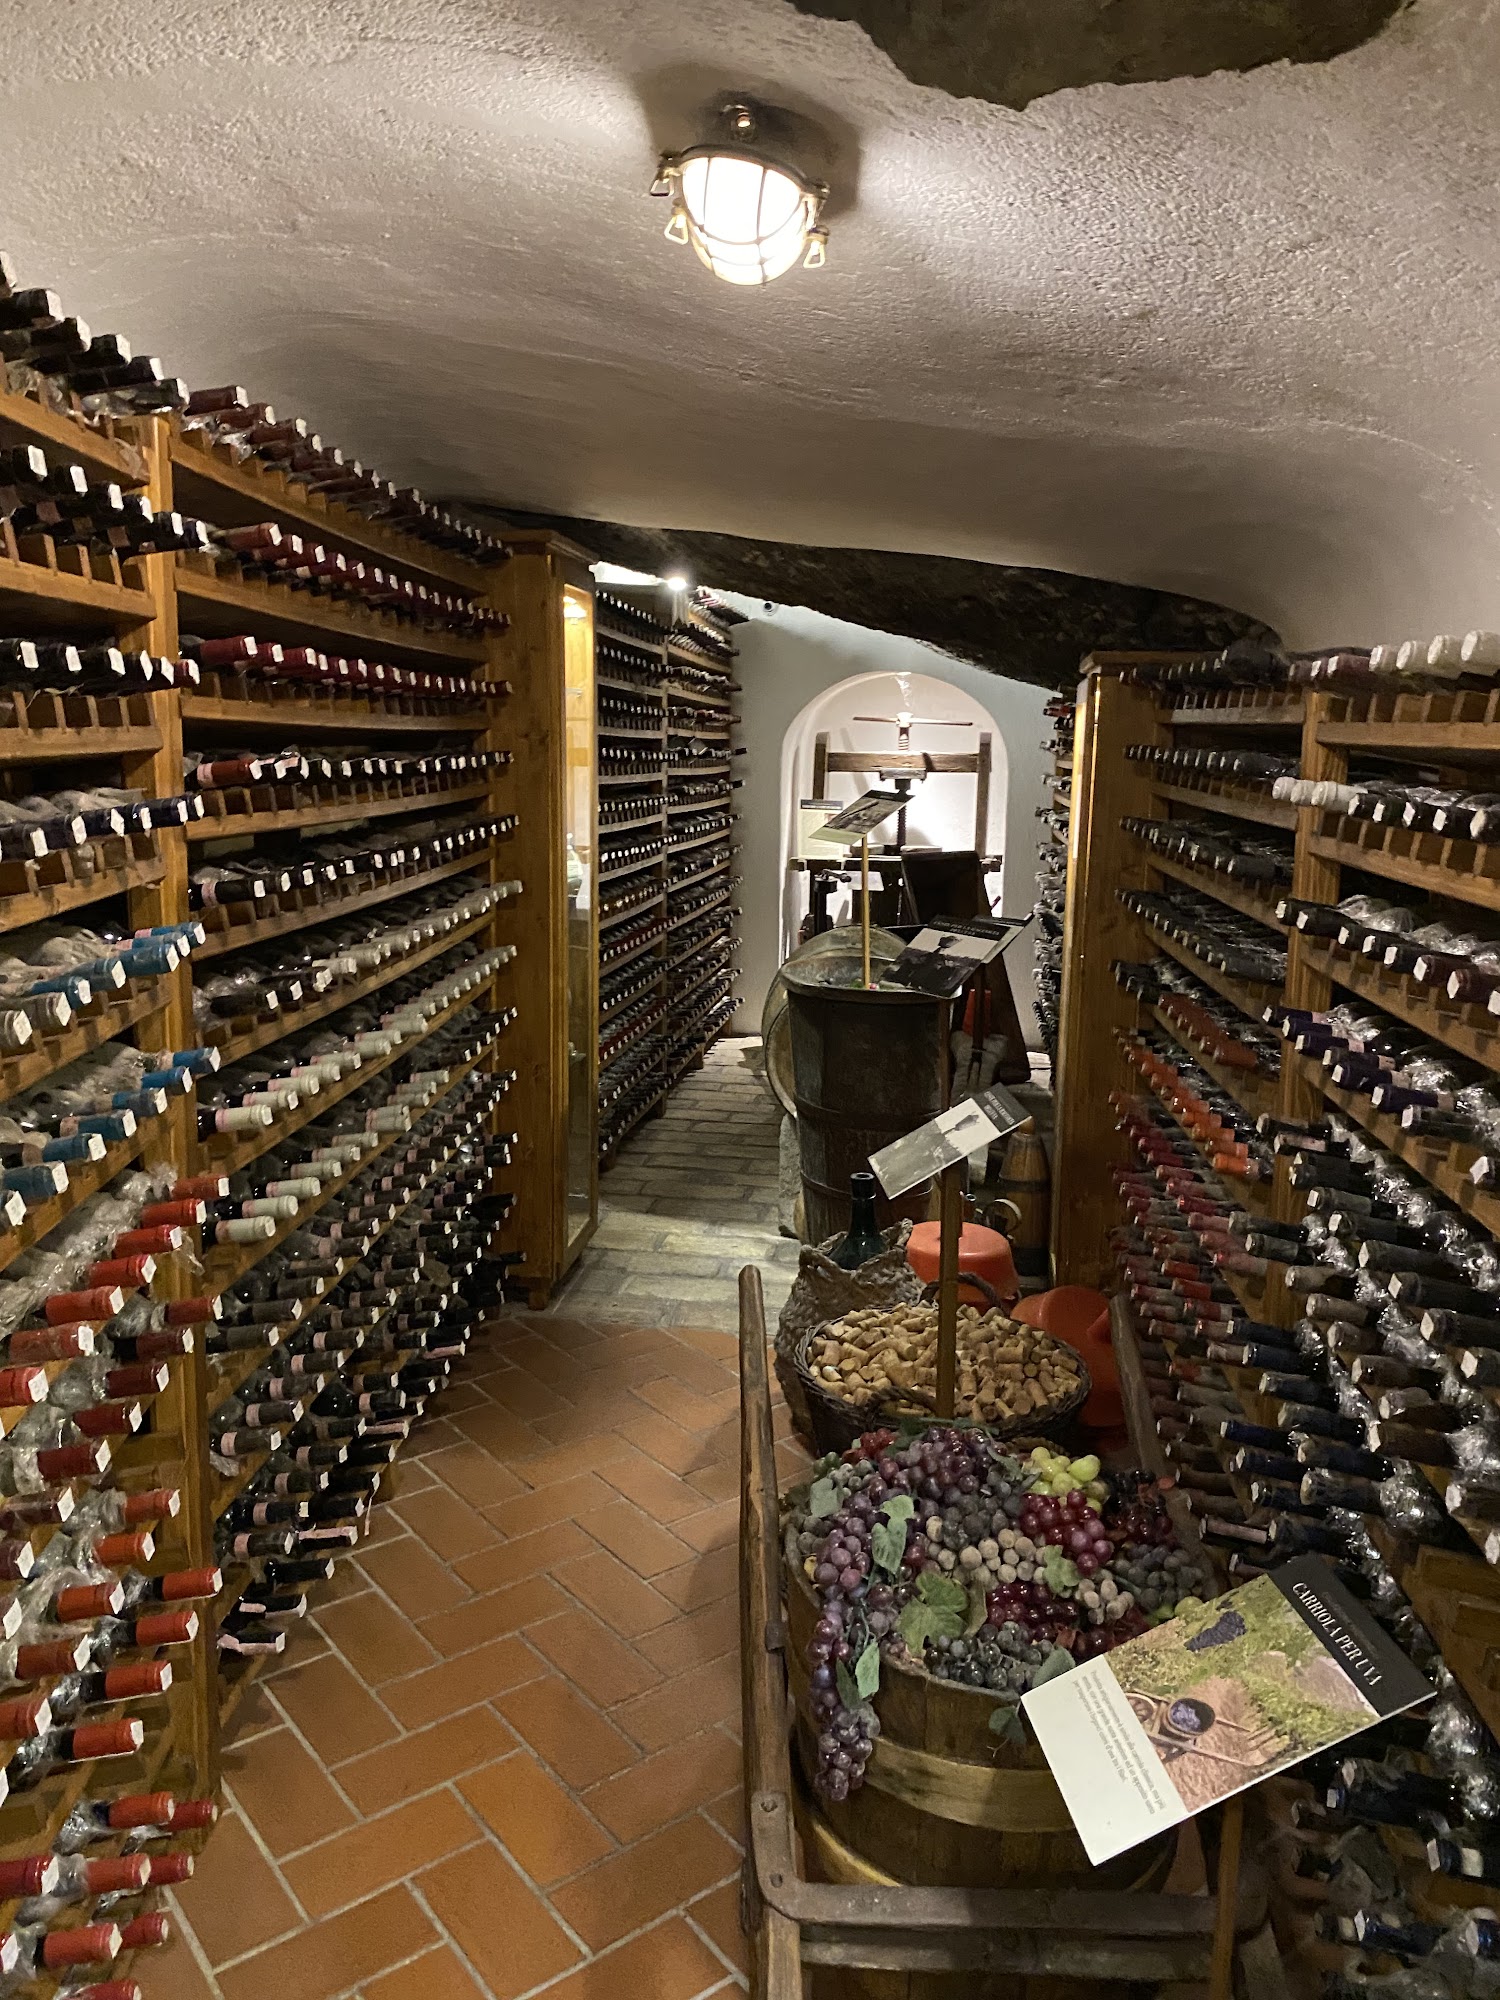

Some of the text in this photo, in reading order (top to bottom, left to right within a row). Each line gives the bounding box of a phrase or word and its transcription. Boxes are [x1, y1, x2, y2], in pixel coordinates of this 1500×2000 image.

[1292, 1582, 1342, 1638] CARRIOLA
[1335, 1634, 1363, 1661] PER
[1355, 1658, 1382, 1686] UVA
